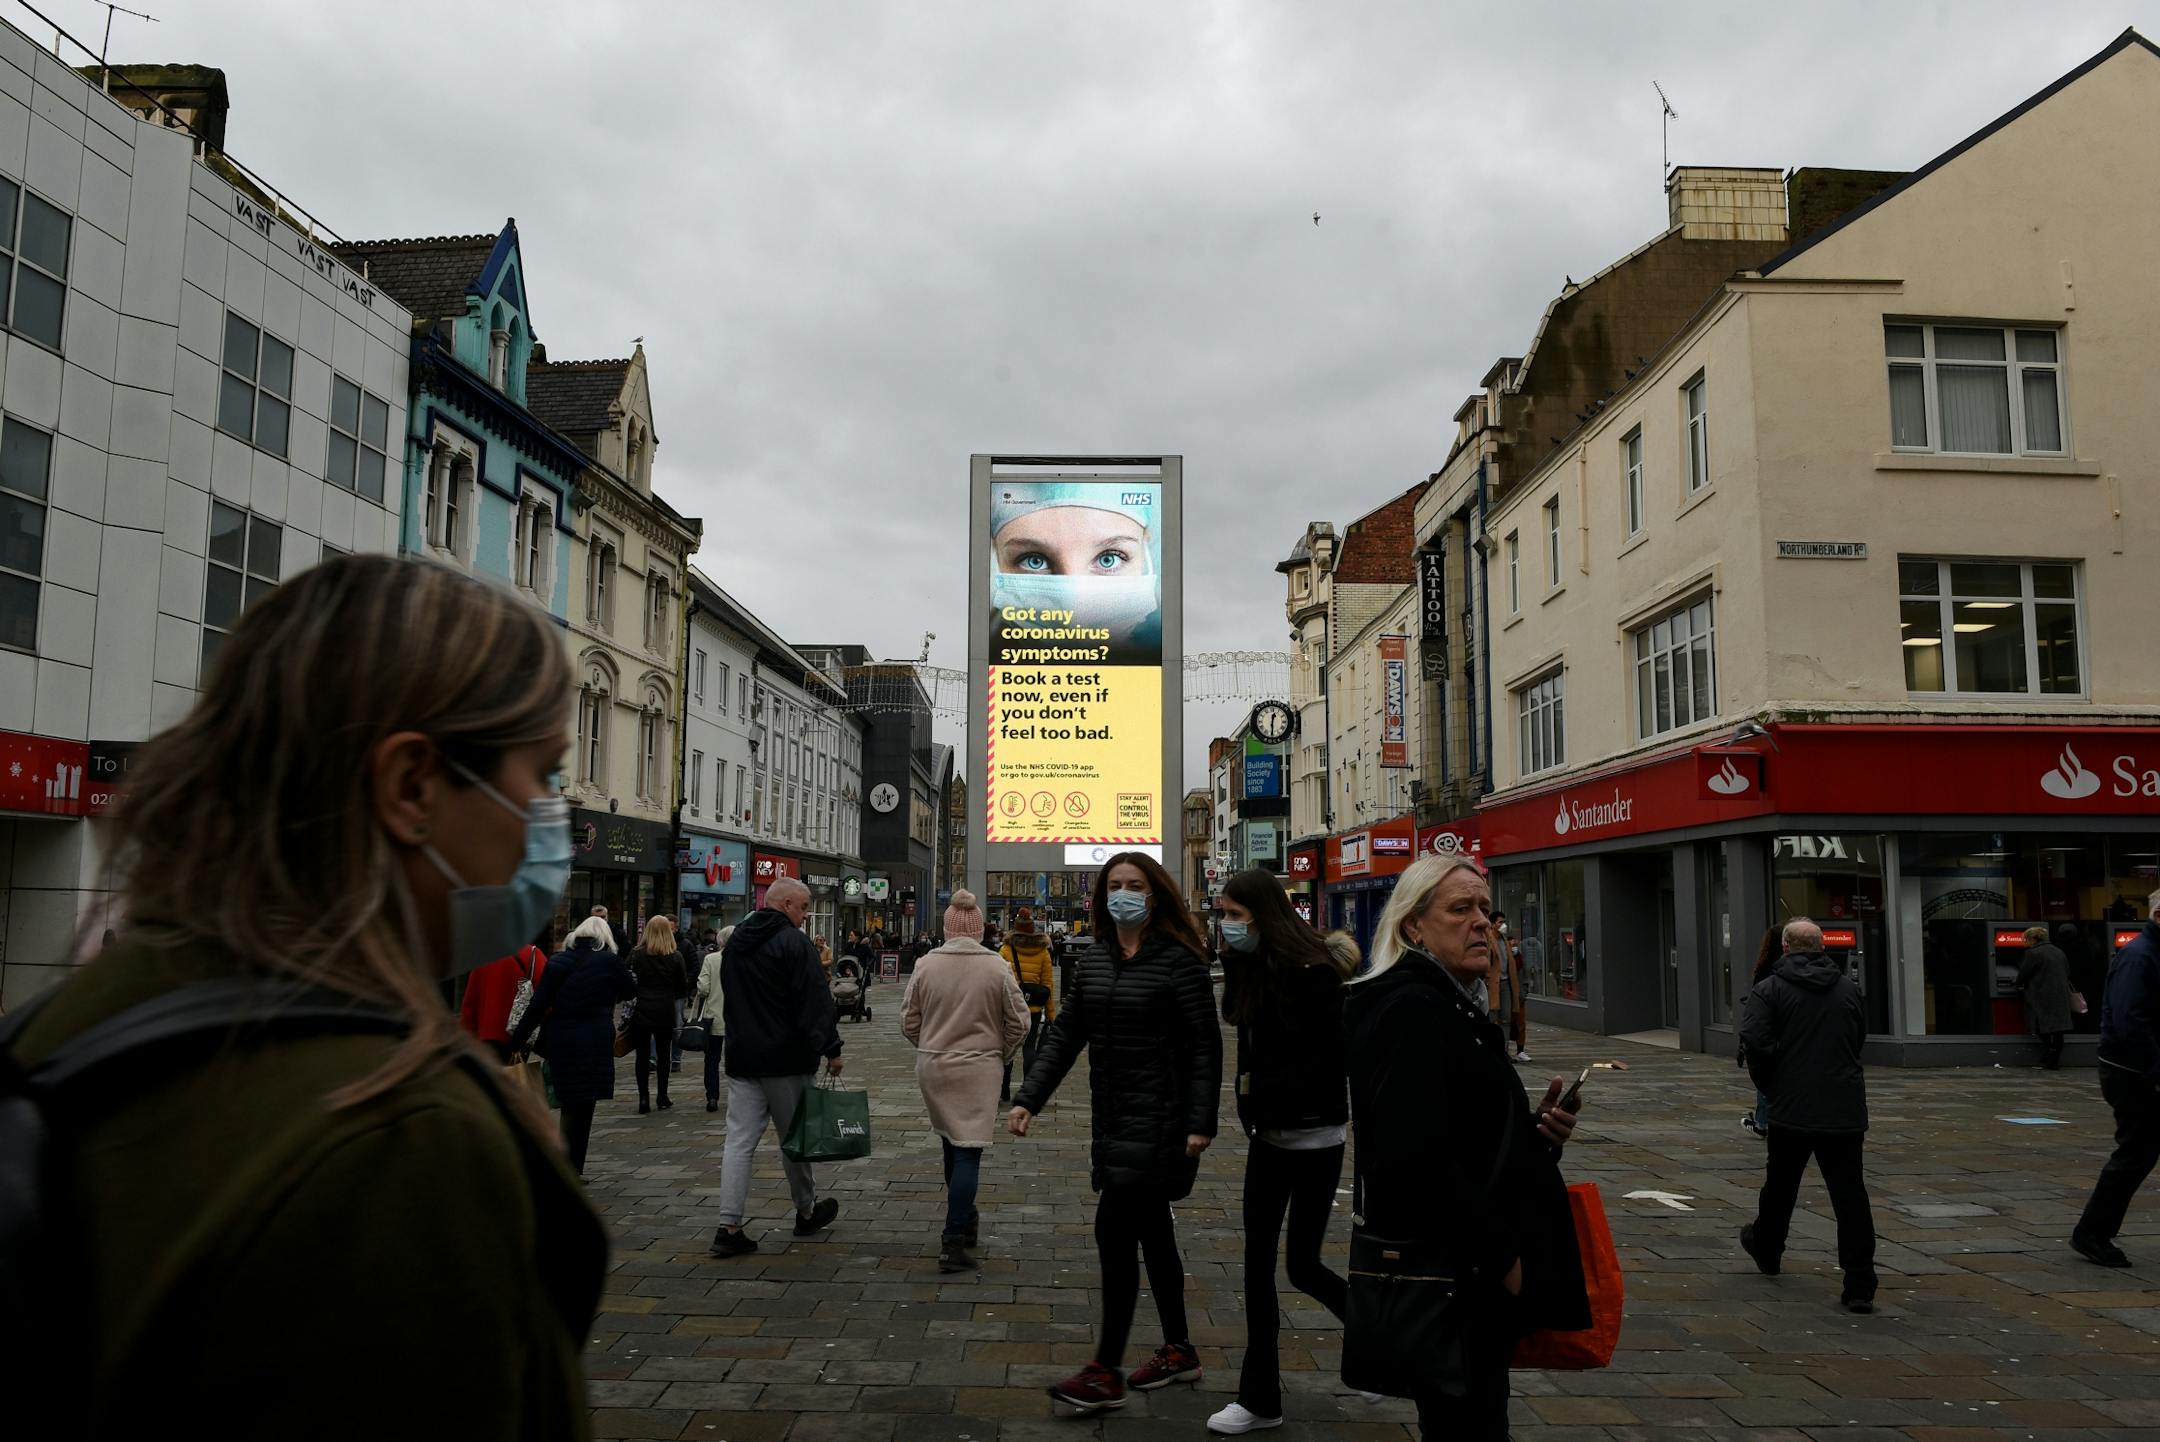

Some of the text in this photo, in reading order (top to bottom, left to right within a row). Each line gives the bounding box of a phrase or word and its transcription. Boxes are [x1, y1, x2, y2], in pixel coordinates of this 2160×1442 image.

[236, 195, 377, 307] VAST VAST VAST
[1122, 493, 1151, 505] NHS
[1780, 543, 1852, 556] NORTHUMBERLAND
[1425, 554, 1441, 623] TATTOO
[1002, 606, 1073, 624] Got any
[1001, 625, 1110, 640] coronavirus
[1001, 645, 1109, 664] symptoms?
[1002, 671, 1101, 685] Book a test
[1001, 689, 1109, 704] now, even if
[1389, 670, 1403, 740] DAWSON
[1001, 706, 1087, 722] you don't
[1001, 725, 1114, 740] feel too bad.
[93, 756, 117, 772] To
[1247, 761, 1274, 770] Building
[1030, 771, 1100, 779] gov.uk/coronavirus
[1247, 770, 1271, 778] Society
[1571, 787, 1633, 830] Santander
